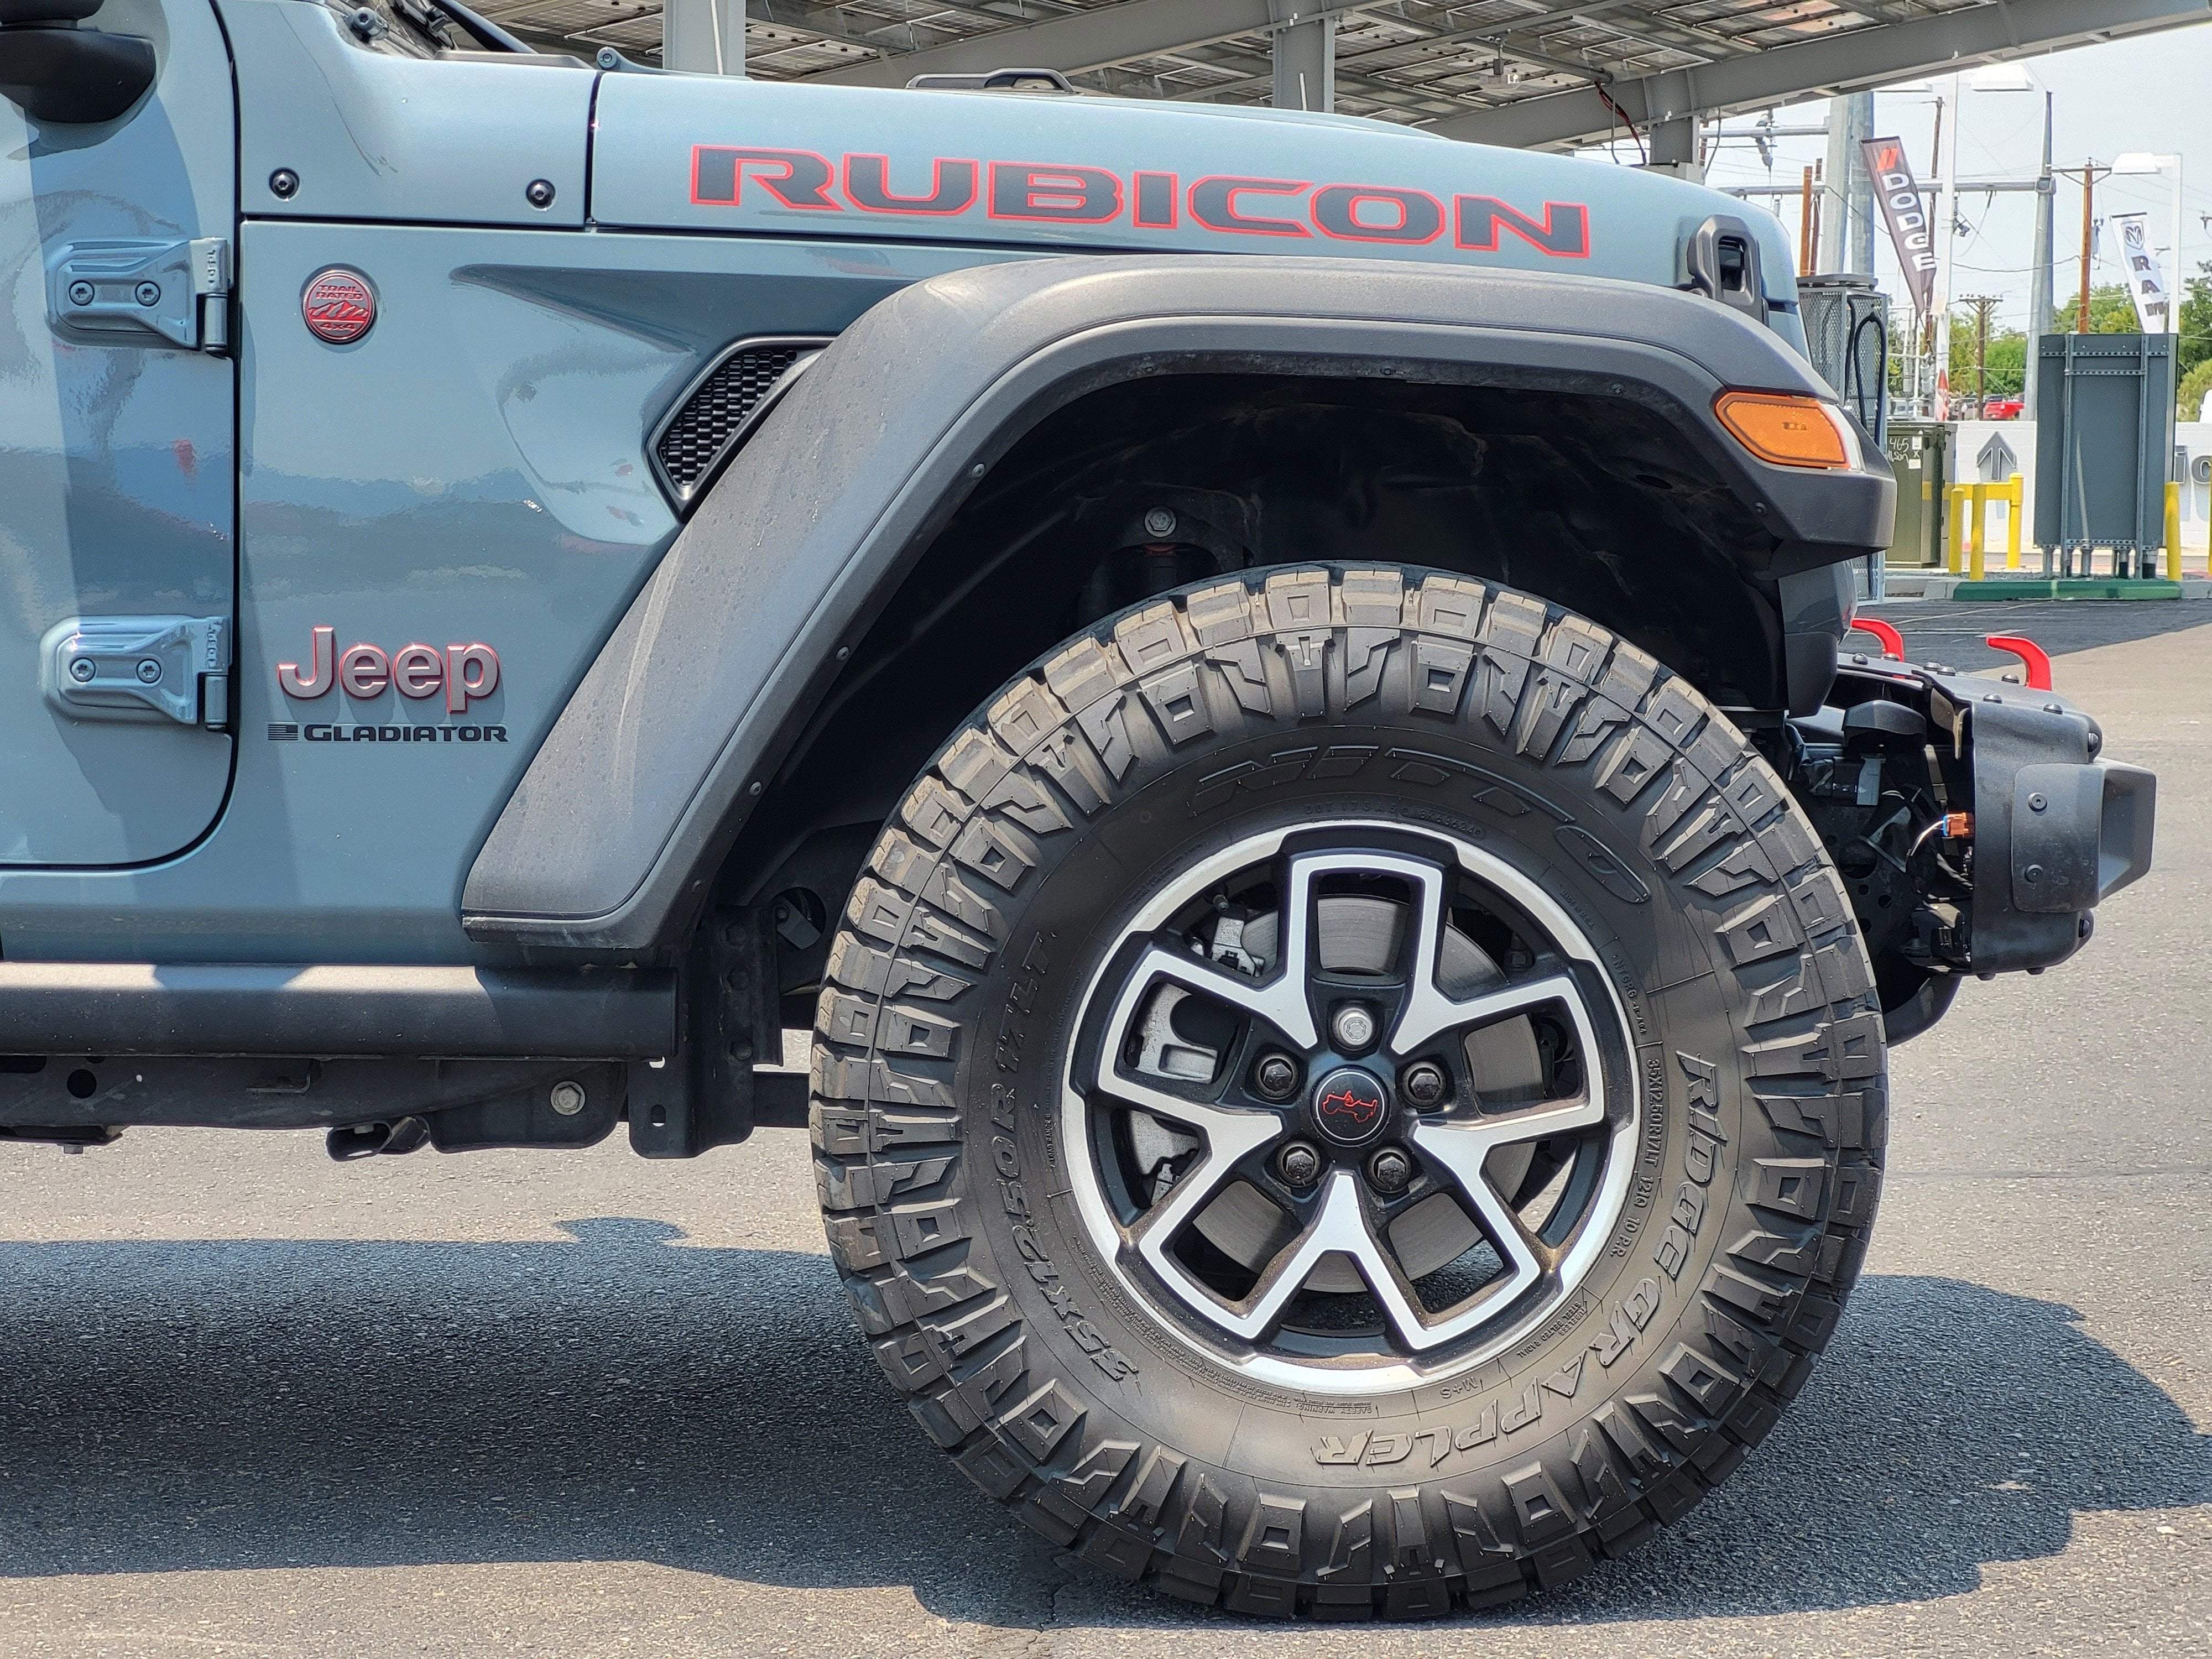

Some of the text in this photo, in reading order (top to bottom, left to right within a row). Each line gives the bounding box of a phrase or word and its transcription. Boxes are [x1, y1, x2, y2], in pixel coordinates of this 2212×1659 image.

[691, 144, 1590, 259] RUBICON
[1882, 173, 1936, 272] DODGE
[315, 292, 363, 300] RATED
[2131, 255, 2166, 316] RAM
[278, 626, 499, 714] Jeep
[304, 726, 509, 742] GLADIATOR
[1316, 1051, 1728, 1467] RIDGE GRAPPLER
[1516, 1301, 1582, 1359] STEEL BELTED RADIAL
[1558, 1308, 1587, 1336] TUBELESS
[1343, 1405, 1373, 1415] SAFETY
[1440, 1377, 1479, 1399] M+S
